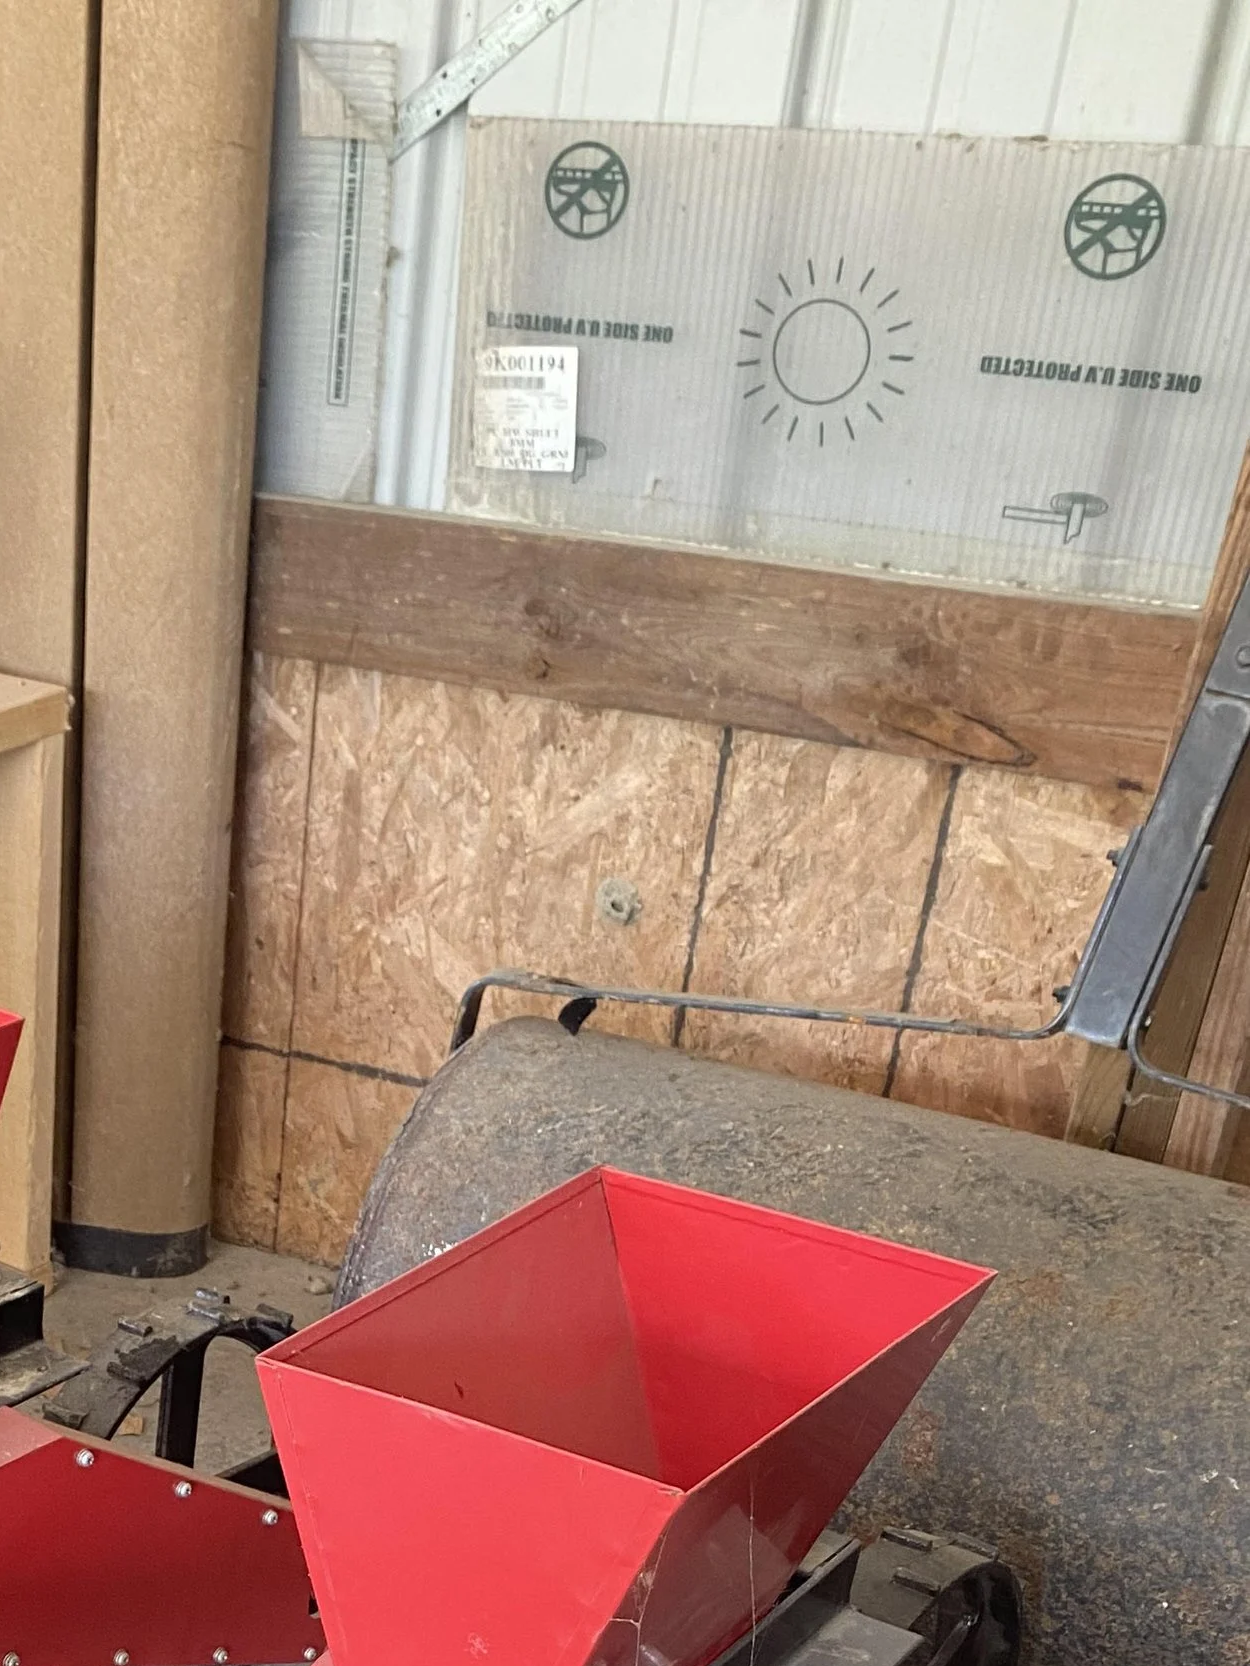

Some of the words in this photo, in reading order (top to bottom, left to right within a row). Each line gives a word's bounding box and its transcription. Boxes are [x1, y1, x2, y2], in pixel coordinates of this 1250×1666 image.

[604, 321, 639, 341] SIDE
[643, 324, 674, 343] ONE
[980, 355, 1083, 382] PROTECTED
[1084, 365, 1116, 386] U.V
[1118, 367, 1162, 390] SIDE
[1163, 371, 1202, 394] ONE
